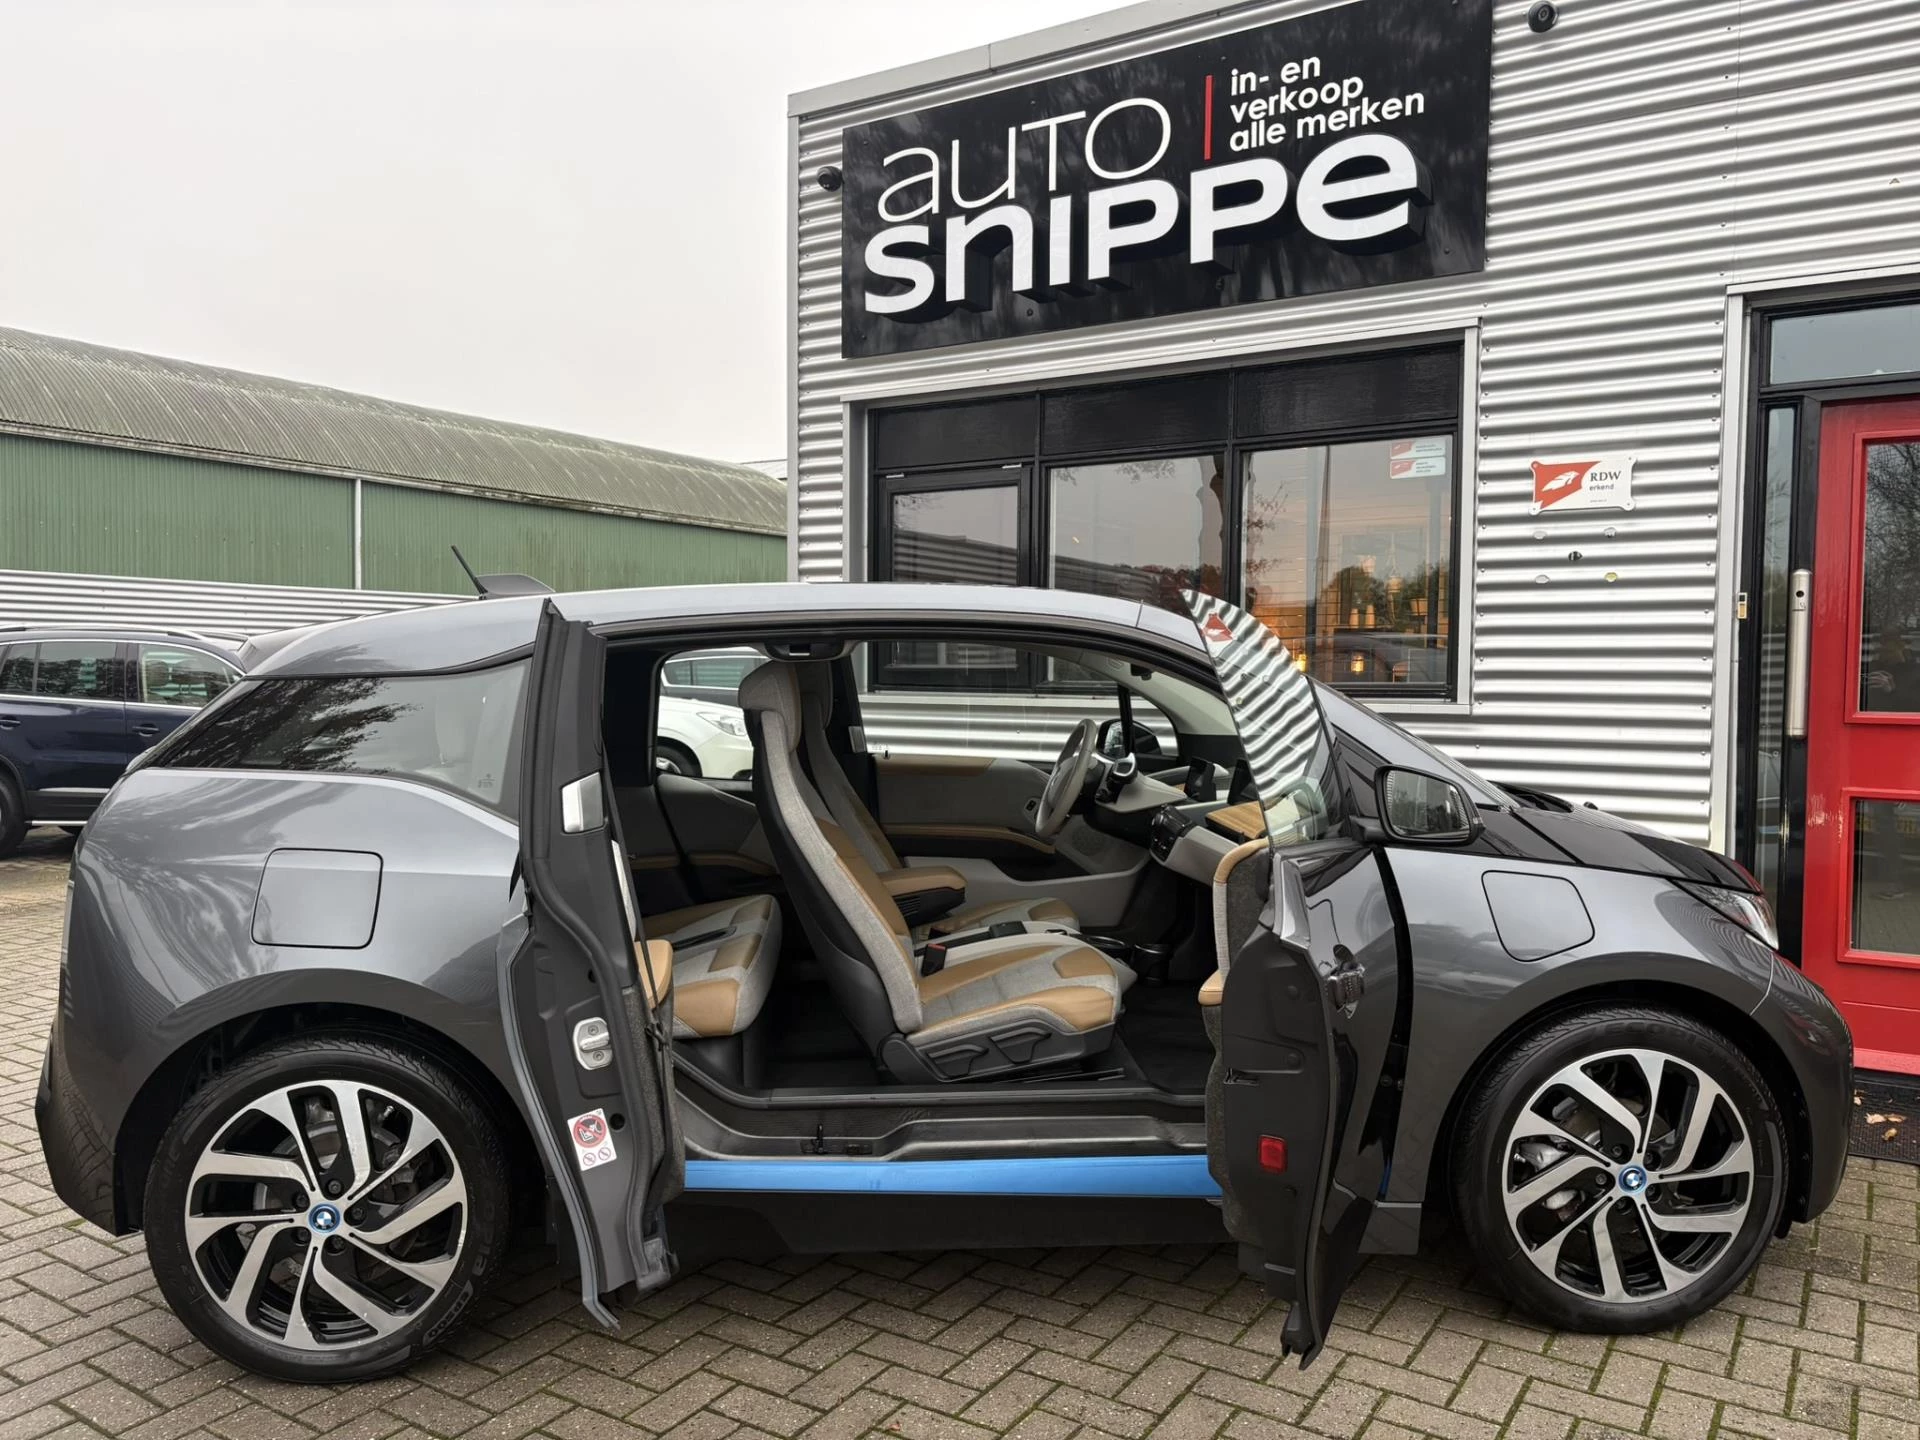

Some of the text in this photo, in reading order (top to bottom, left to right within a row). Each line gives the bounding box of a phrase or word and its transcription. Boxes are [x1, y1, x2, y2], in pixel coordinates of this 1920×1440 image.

[1231, 56, 1321, 97] in- en
[1229, 76, 1364, 124] verkoop
[1229, 92, 1425, 152] alle merken
[1590, 470, 1622, 482] RDW
